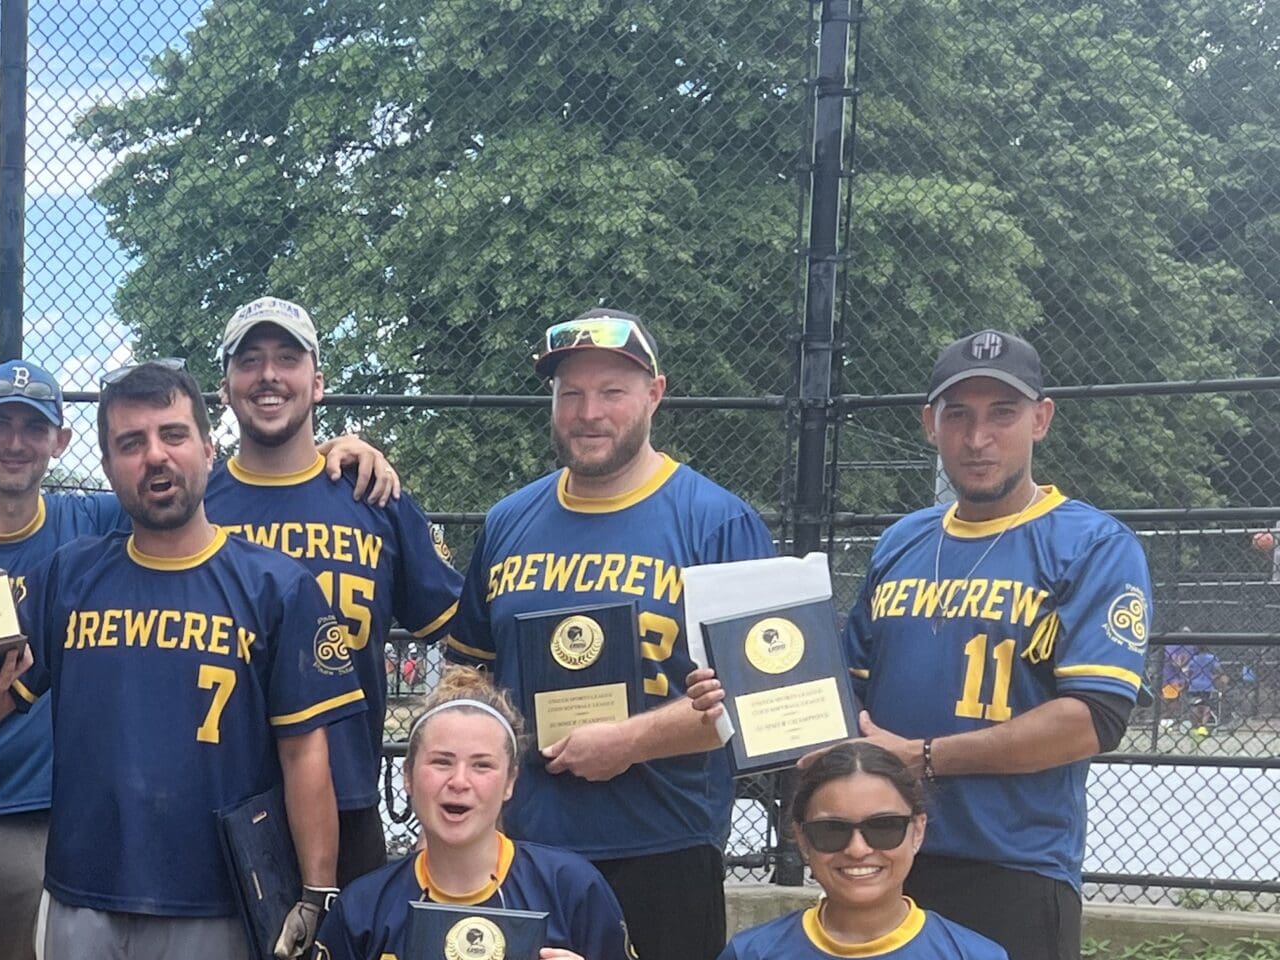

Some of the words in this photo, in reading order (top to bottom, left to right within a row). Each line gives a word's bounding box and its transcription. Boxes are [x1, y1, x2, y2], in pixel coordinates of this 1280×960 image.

[12, 366, 30, 388] B
[196, 663, 236, 744] 7
[955, 633, 1016, 721] 11
